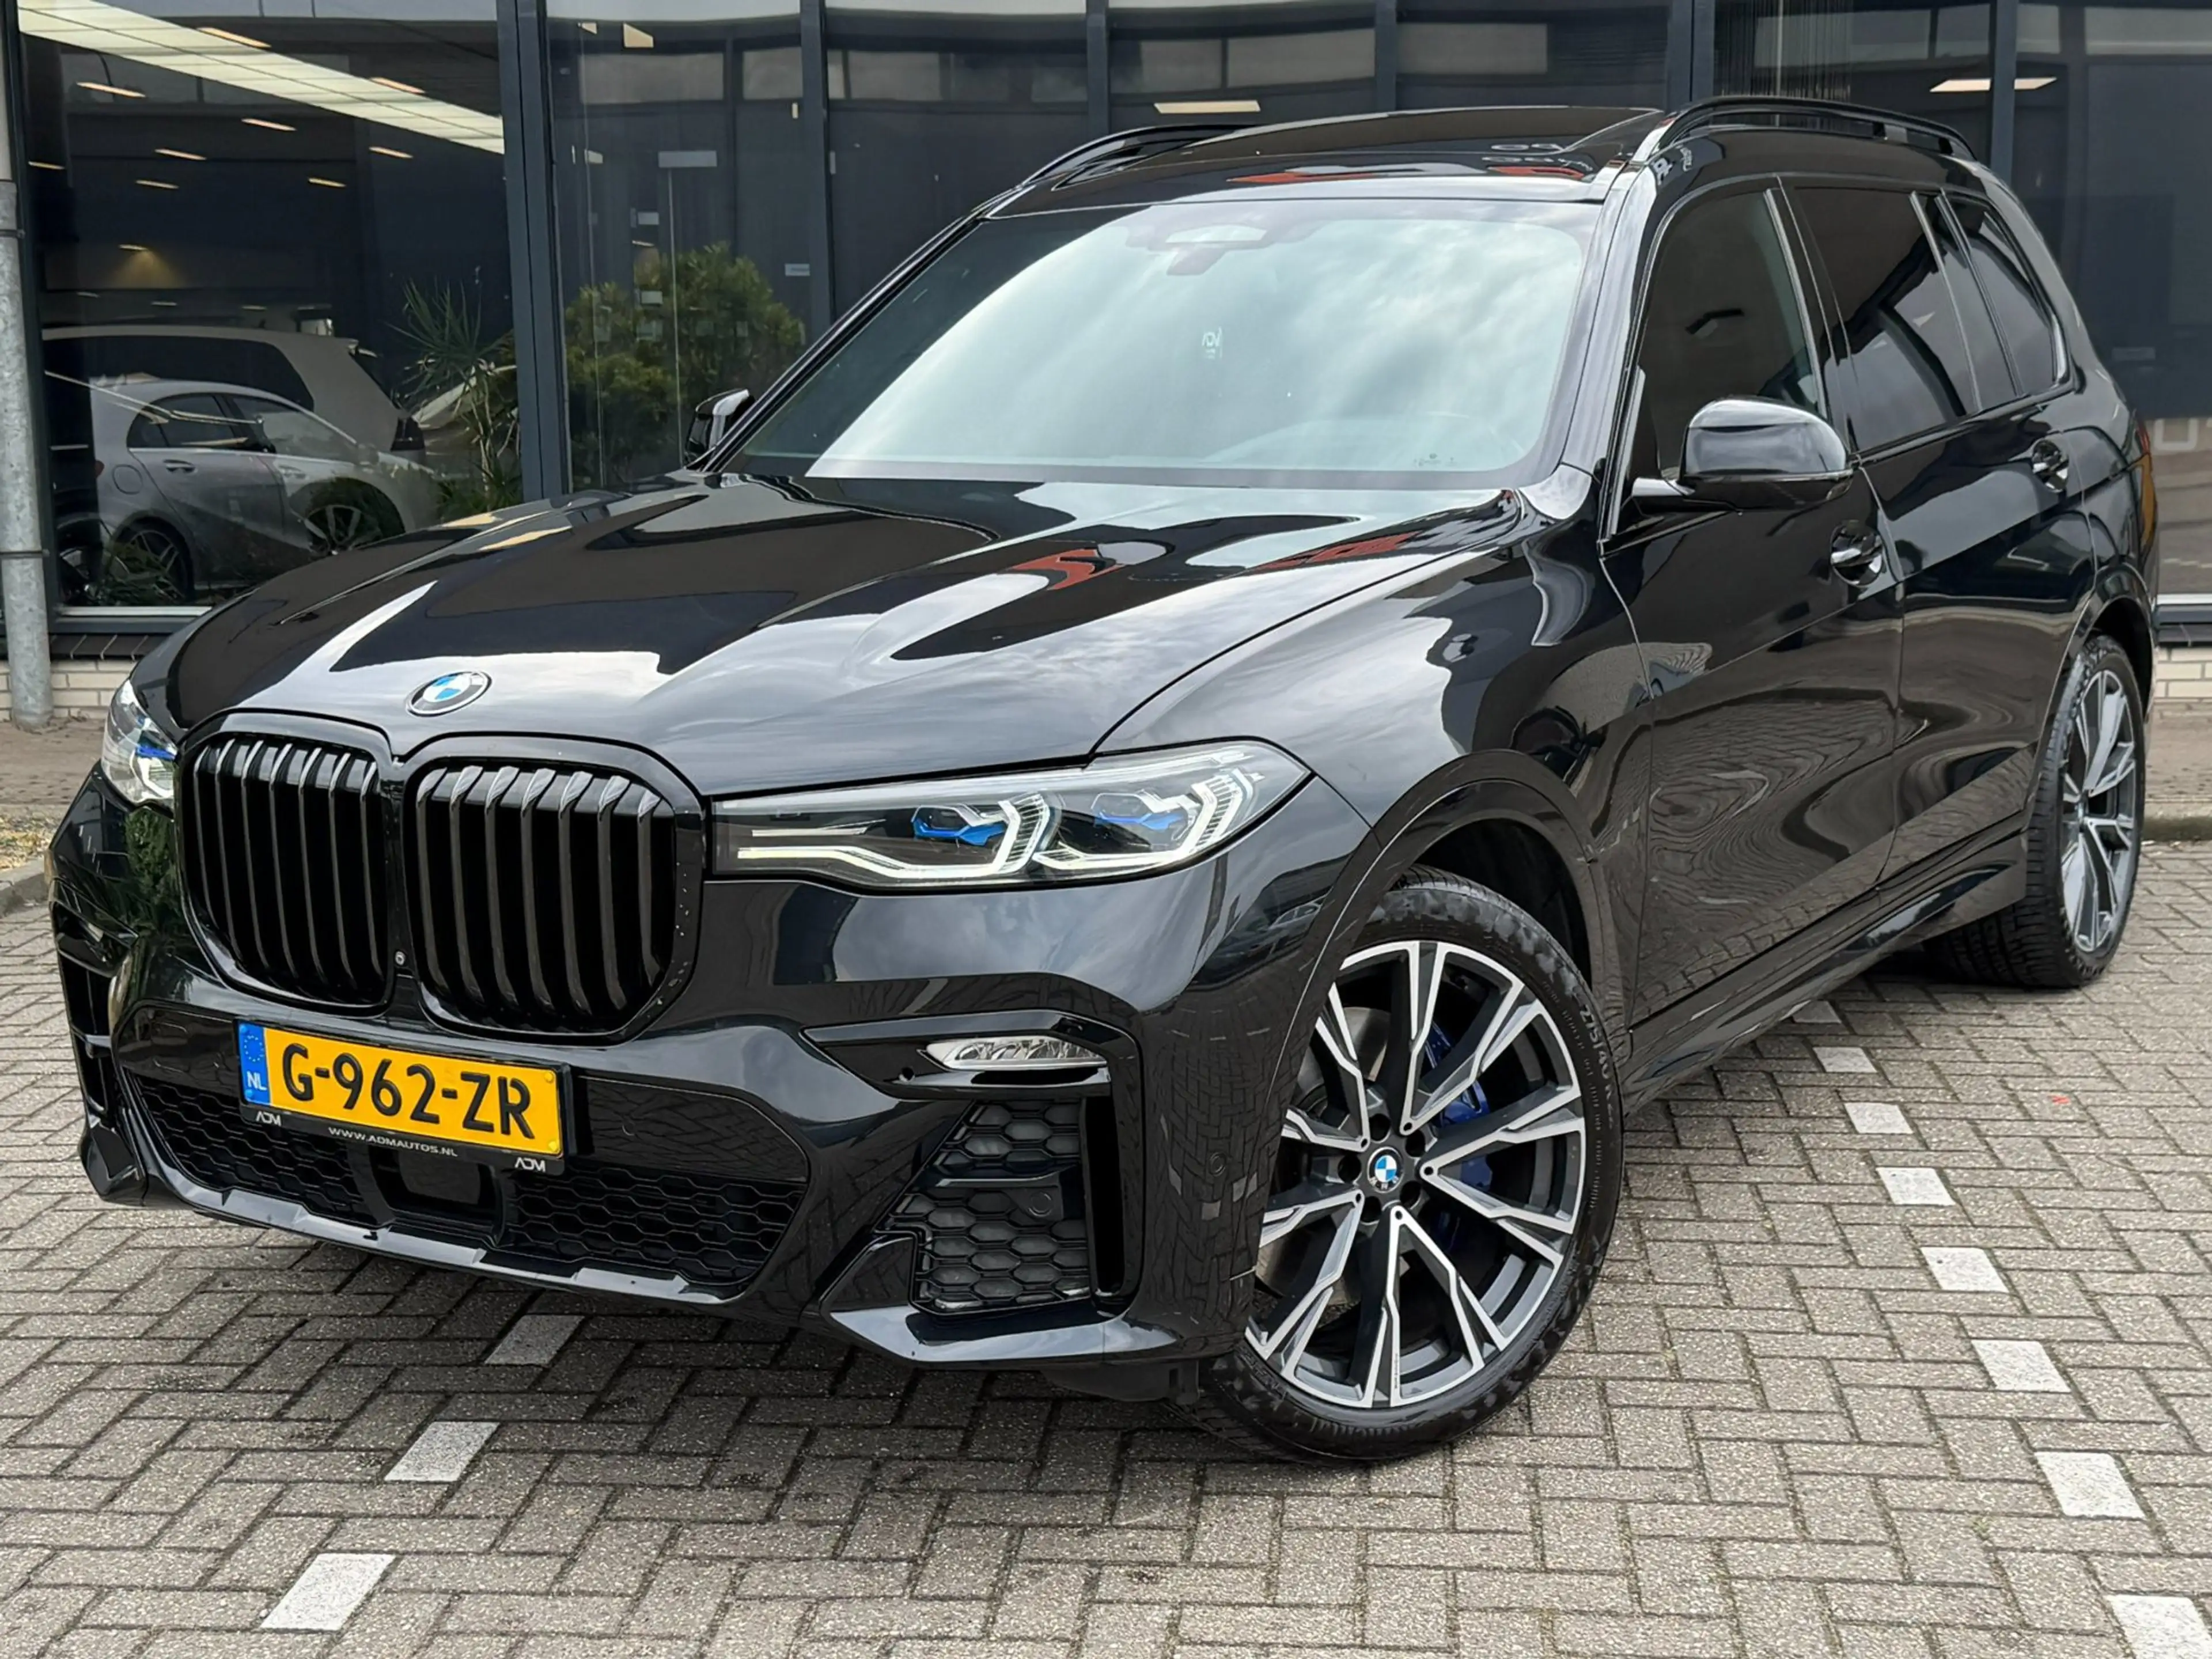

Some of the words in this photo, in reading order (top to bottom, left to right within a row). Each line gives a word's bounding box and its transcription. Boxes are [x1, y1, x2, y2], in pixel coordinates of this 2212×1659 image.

[247, 1071, 267, 1090] NL
[283, 1043, 535, 1139] G-962-ZR
[328, 1127, 459, 1157] WWW.ADMAUTOS.NL
